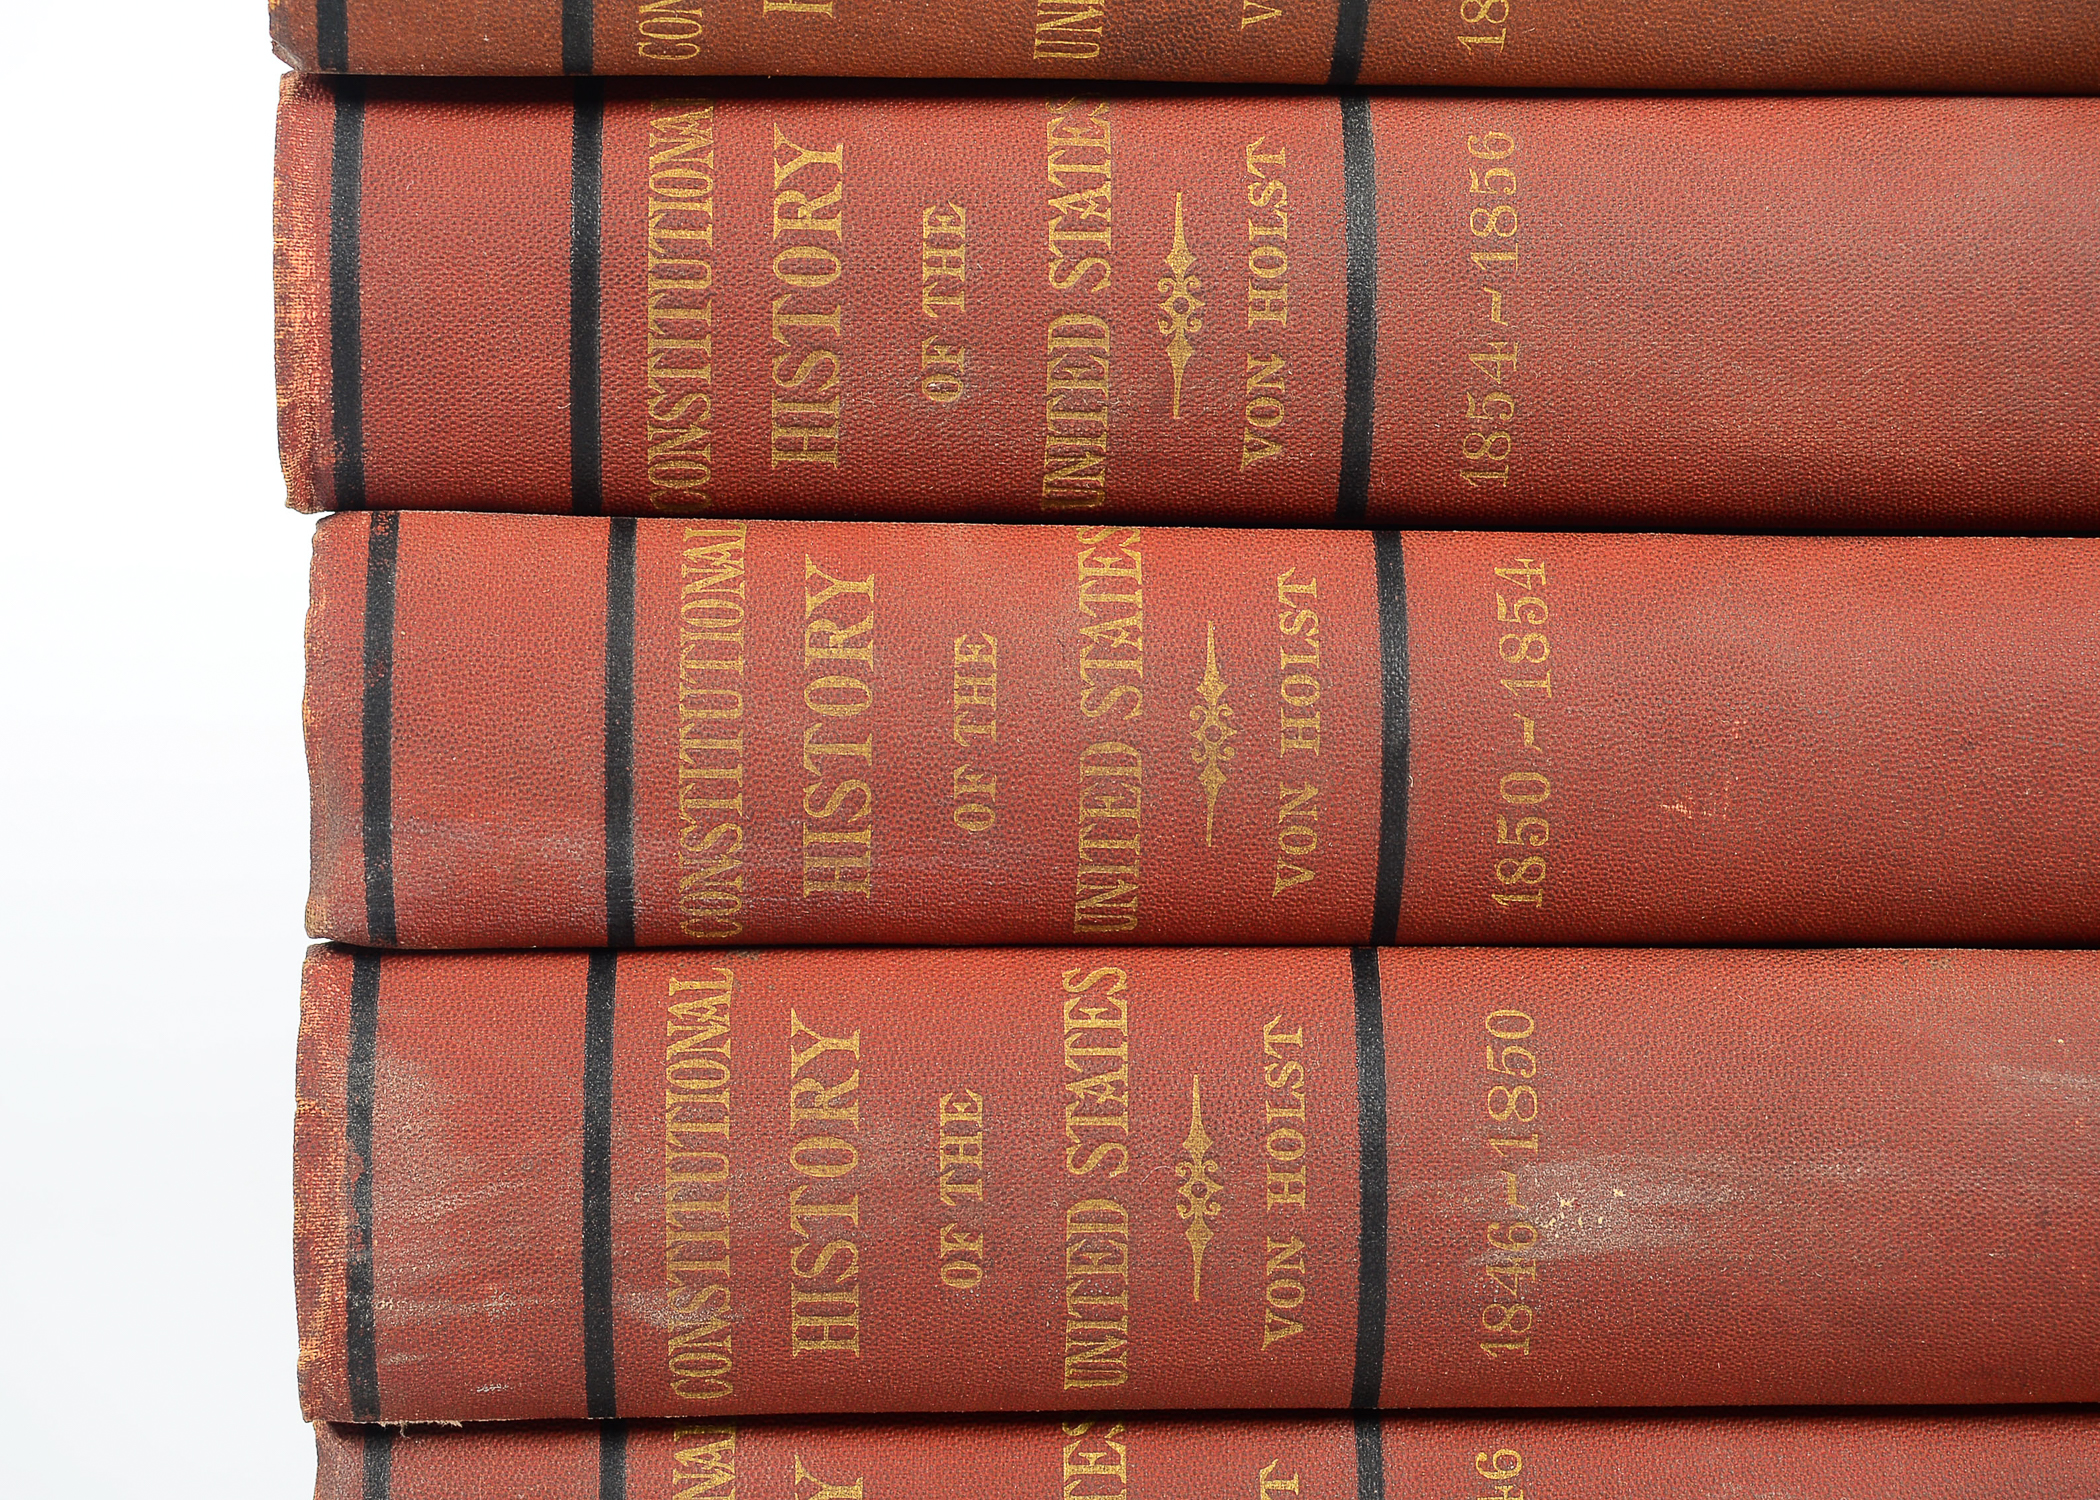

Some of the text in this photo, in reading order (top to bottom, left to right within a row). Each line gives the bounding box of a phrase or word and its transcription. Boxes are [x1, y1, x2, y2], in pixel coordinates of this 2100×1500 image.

[771, 124, 843, 468] HISTORY
[922, 203, 967, 401] OF THE
[1042, 313, 1110, 510] UNITED
[1241, 137, 1289, 472] VON HOLST
[679, 521, 746, 938] CONSTITUTIONAL
[803, 554, 875, 897] HISTORY
[953, 633, 998, 832] OF THE
[1075, 526, 1144, 933] UNITED STATES
[1273, 567, 1321, 897] VON HOLST
[665, 967, 735, 1400] CONSTITUTIONAL
[790, 1009, 861, 1357] HISTORY
[940, 1089, 984, 1288] OF THE
[1063, 966, 1130, 1390] UNITED STATES
[1262, 1015, 1307, 1350] VON HOLST
